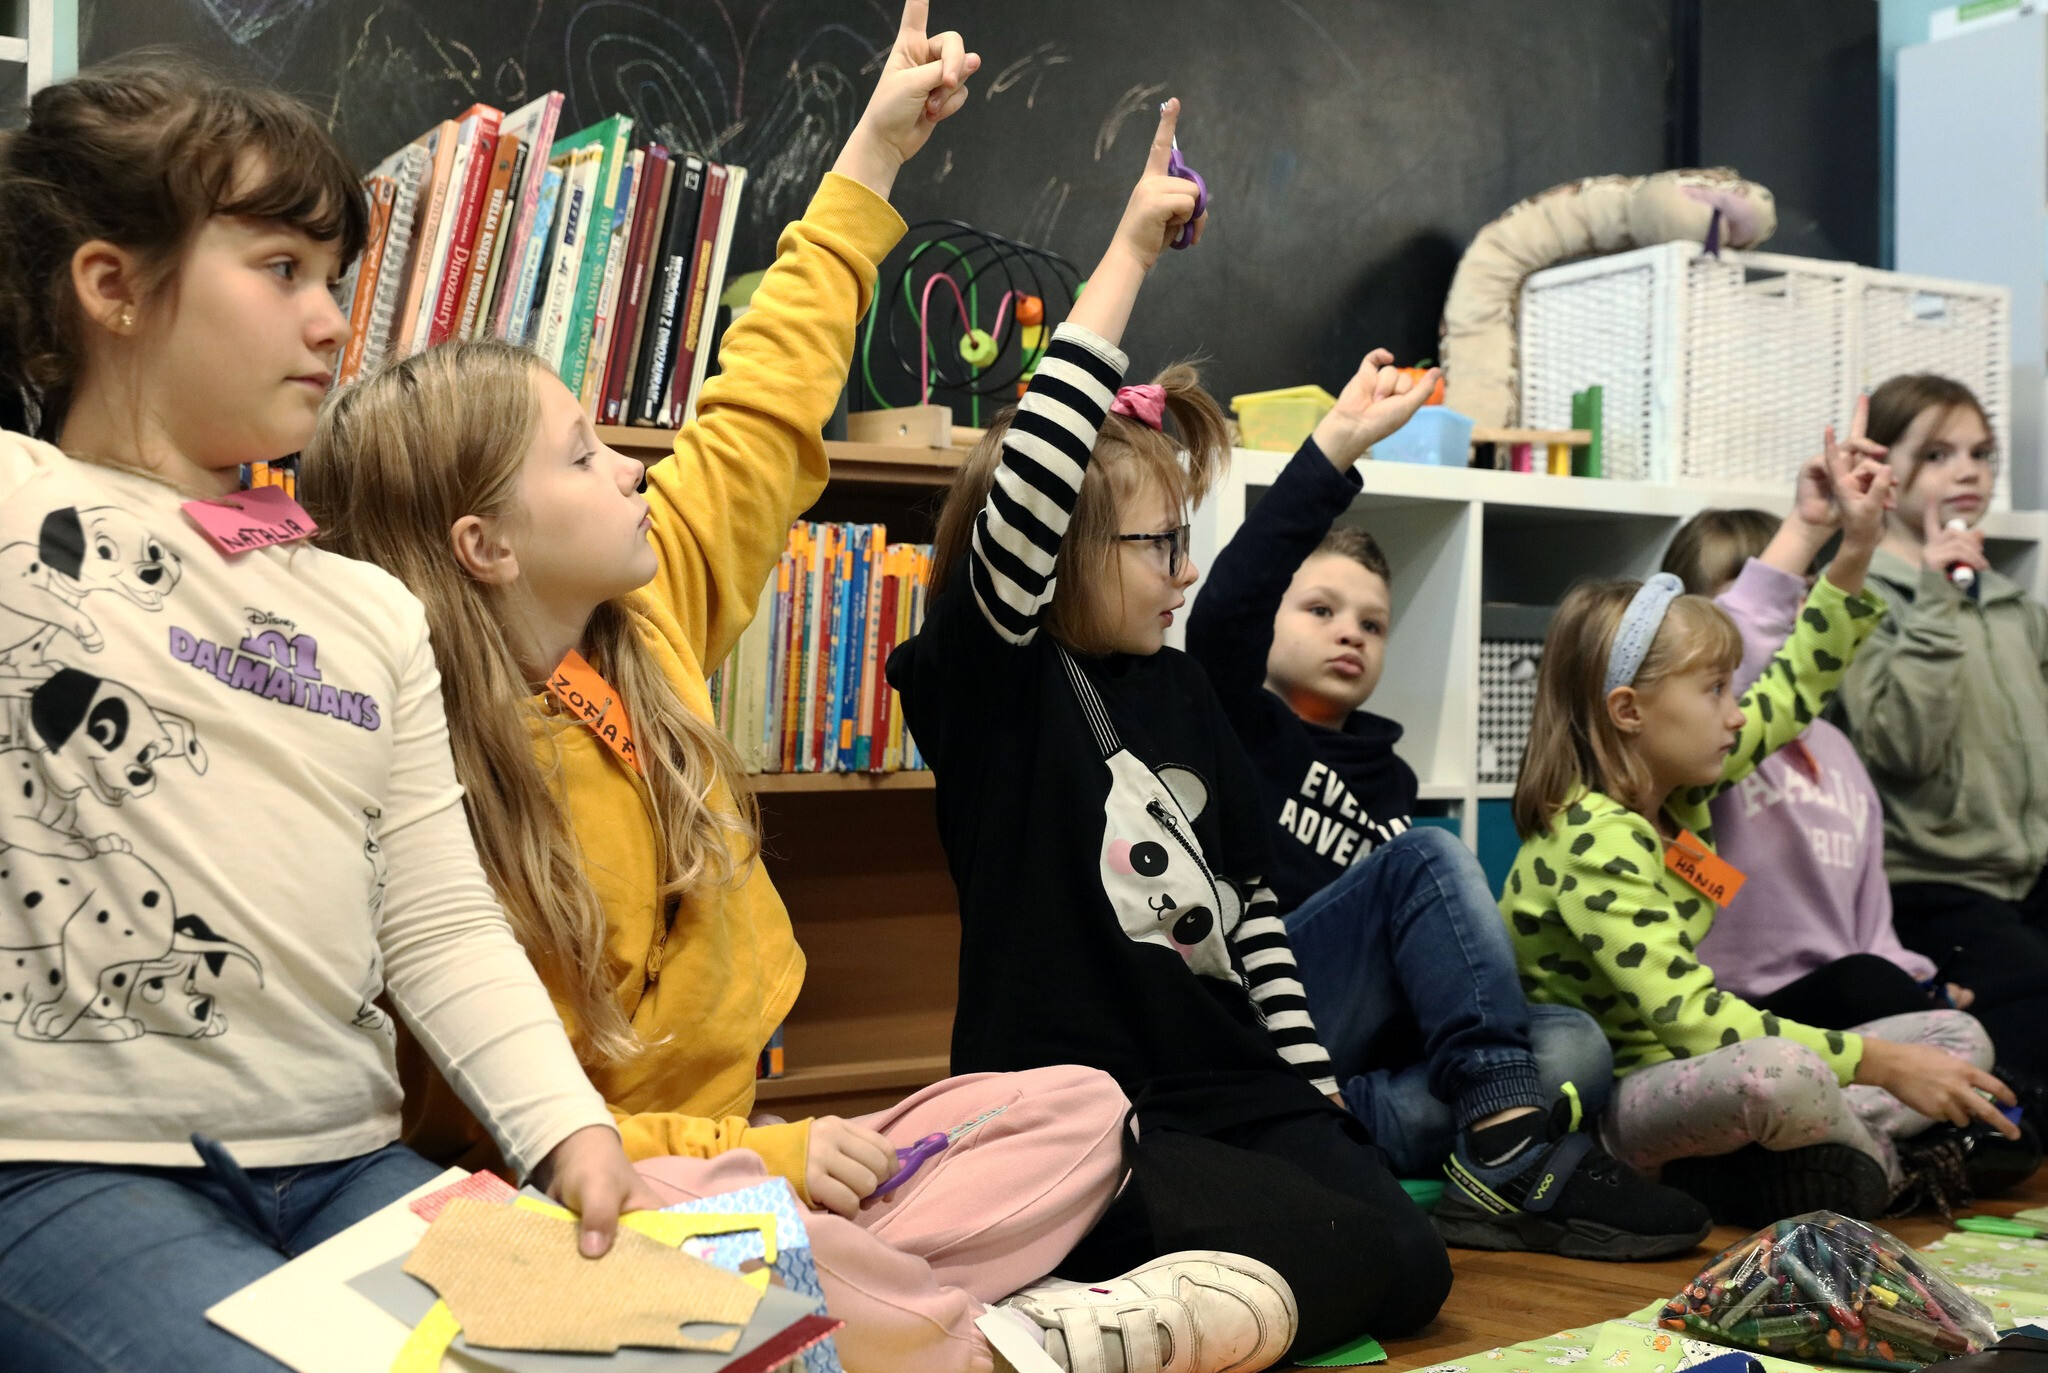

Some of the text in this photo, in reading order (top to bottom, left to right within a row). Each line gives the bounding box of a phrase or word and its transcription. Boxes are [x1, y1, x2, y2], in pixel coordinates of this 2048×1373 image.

[483, 187, 504, 231] WIELKA
[471, 230, 494, 271] KSIĘGA
[594, 214, 612, 256] ATLAS
[432, 244, 470, 330] Dinozaury
[584, 263, 604, 311] ŚWIATA
[658, 316, 672, 326] Z
[219, 518, 305, 550] NATALIA
[243, 607, 297, 632] Disney
[169, 625, 382, 732] DALMATIANS
[551, 673, 618, 743] ZOFIA
[1674, 855, 1726, 901] HANIA
